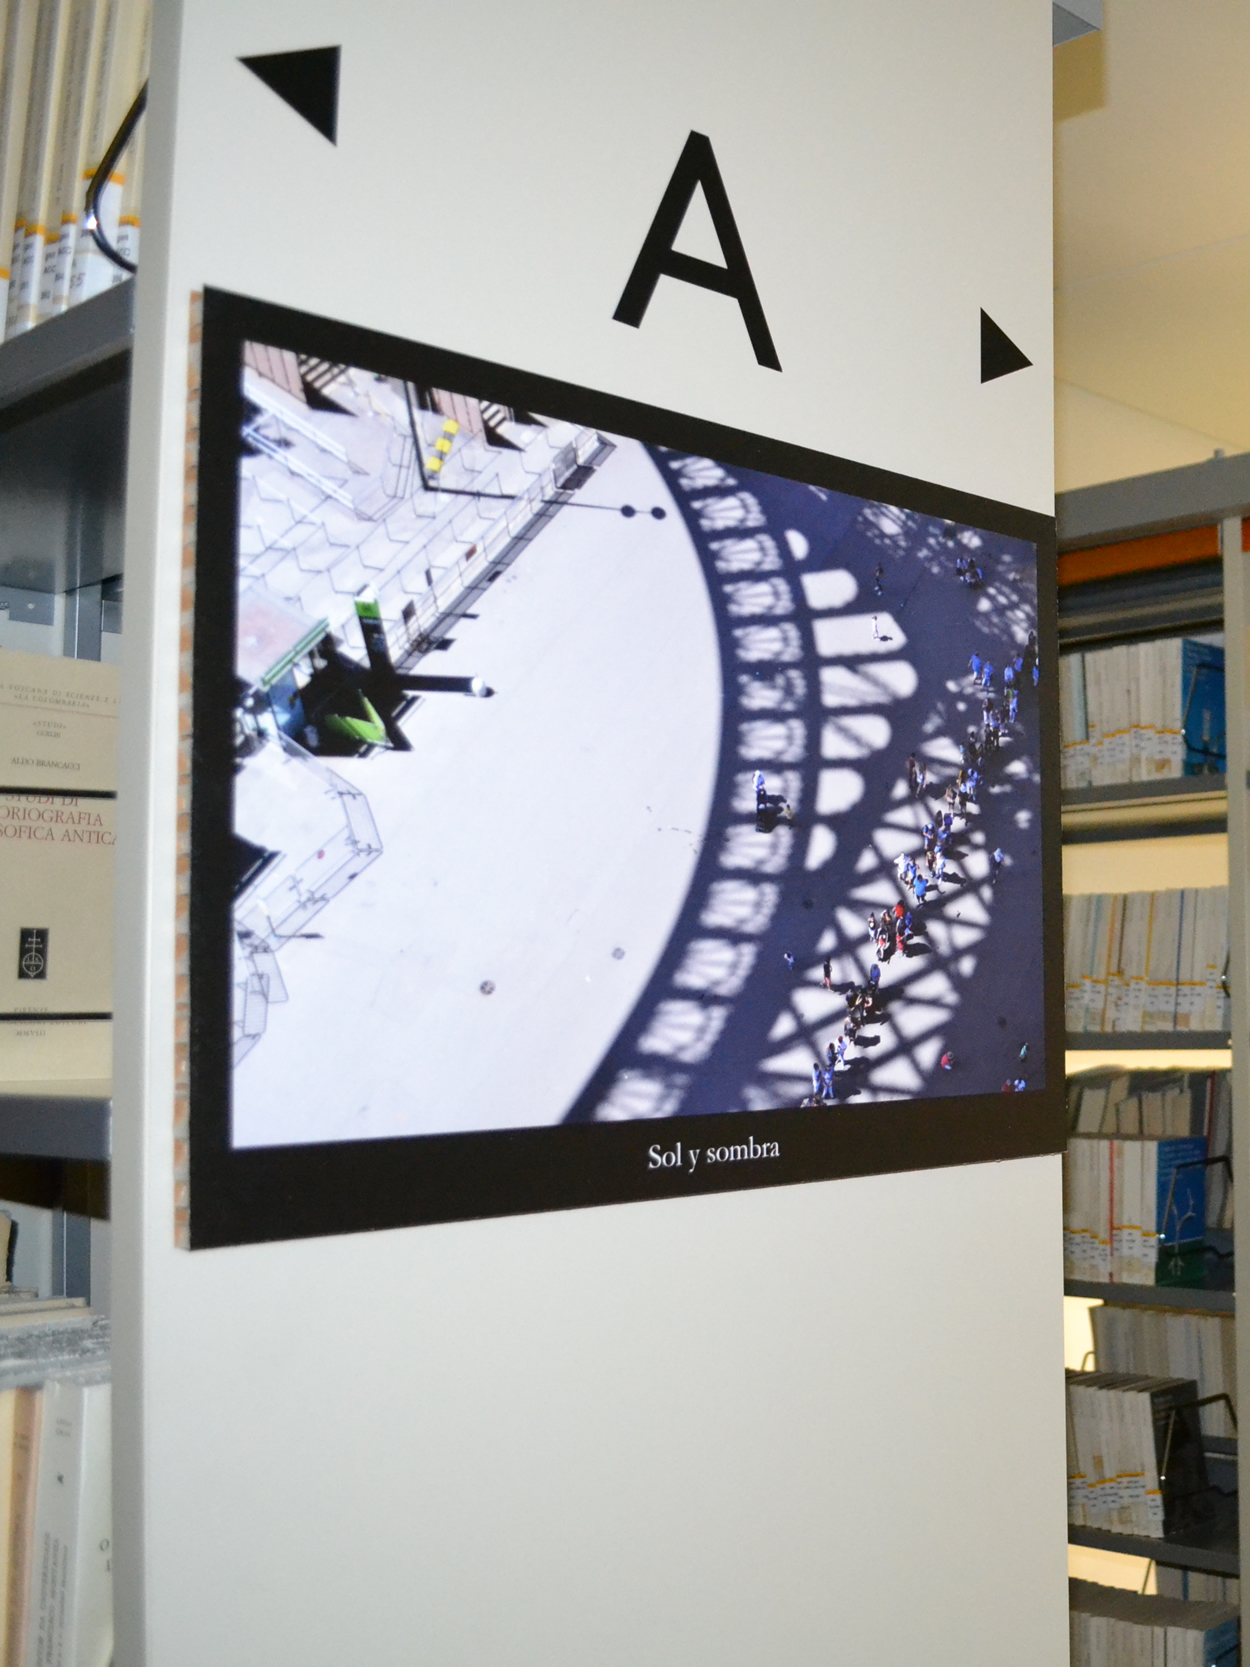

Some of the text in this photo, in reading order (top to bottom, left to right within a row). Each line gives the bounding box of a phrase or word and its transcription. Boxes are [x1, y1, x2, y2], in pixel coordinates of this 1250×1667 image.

[612, 130, 783, 373] A
[36, 758, 81, 771] BRANCACCI
[648, 1136, 781, 1174] Sol y sombra
